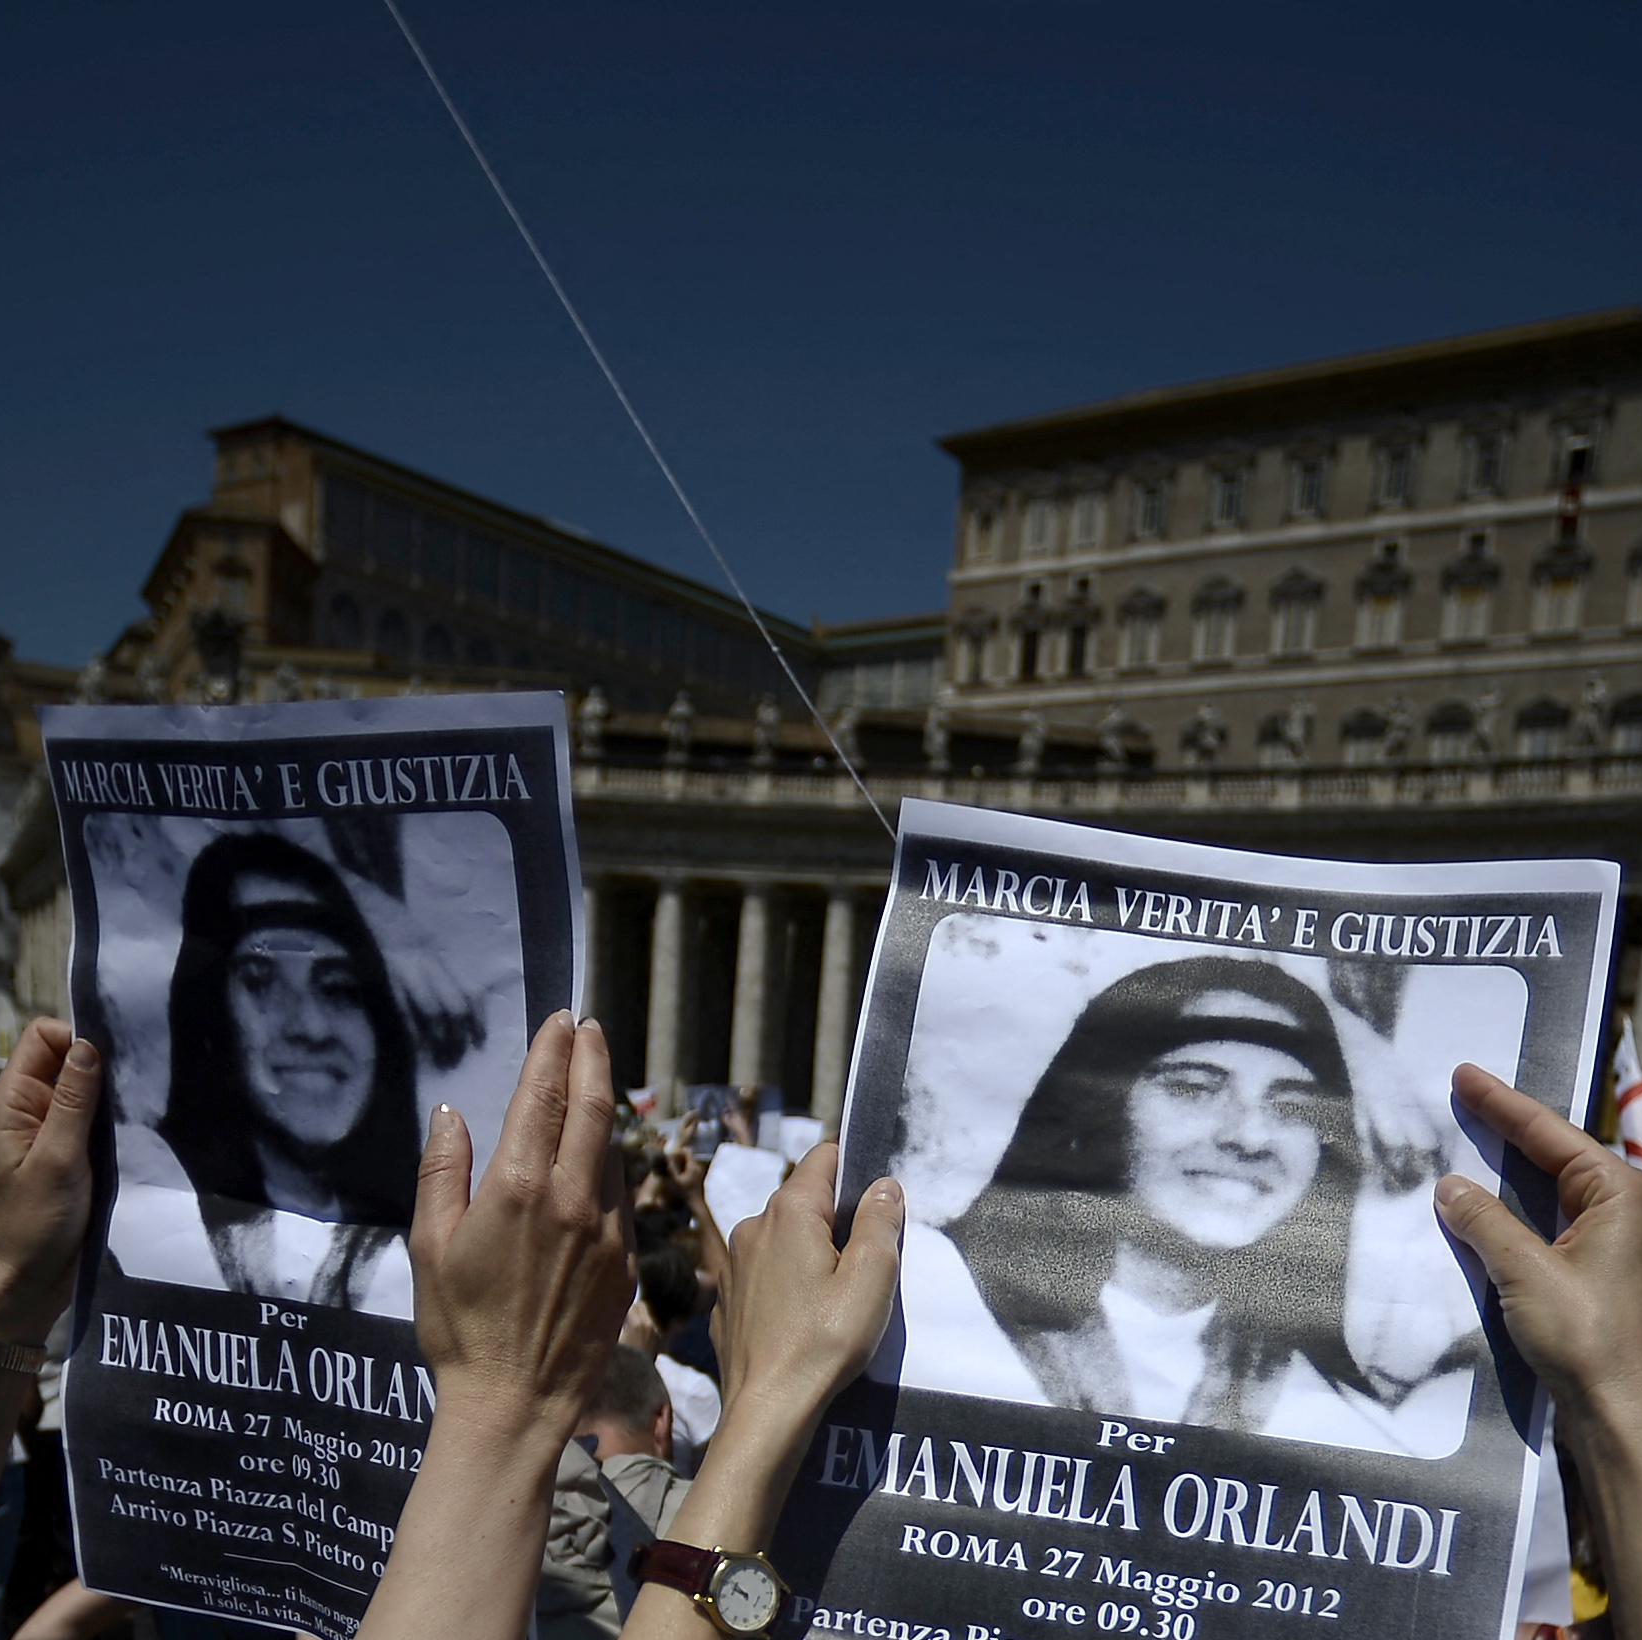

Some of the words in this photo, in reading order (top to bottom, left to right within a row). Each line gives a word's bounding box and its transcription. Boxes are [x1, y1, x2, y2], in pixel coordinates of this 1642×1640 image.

[61, 760, 155, 807] MARCIA
[157, 762, 263, 812] VERITA’
[277, 763, 306, 809] E
[317, 752, 532, 808] GIUSTIZIA
[918, 858, 1094, 925] MARCIA
[1114, 885, 1283, 945] VERITA’
[1291, 908, 1320, 949] E
[1330, 911, 1564, 959] GIUSTIZIA
[259, 1302, 308, 1330] Per
[99, 1312, 301, 1396] EMANUELA
[154, 1397, 235, 1434] ROMA
[243, 1413, 271, 1438] 27
[283, 1416, 362, 1463] Maggio
[369, 1438, 422, 1474] 2012
[1097, 1420, 1175, 1454] Per
[98, 1457, 203, 1498] Partenza
[210, 1477, 293, 1511] Piazza
[296, 1498, 326, 1523] del
[239, 1454, 285, 1474] ore
[291, 1454, 341, 1491] 09.30
[816, 1423, 1140, 1531] EMANUELA
[1163, 1472, 1461, 1576] ORLANDI
[110, 1493, 187, 1528] Arrivo
[193, 1508, 274, 1543] Piazza
[281, 1523, 301, 1548] S.
[305, 1529, 366, 1572] Pietro
[283, 1585, 297, 1601] ti
[299, 1588, 331, 1618] hanno
[900, 1524, 1028, 1571] ROMA
[1039, 1546, 1085, 1579] 27
[1092, 1555, 1241, 1610] Maggio
[1251, 1579, 1342, 1619] 2012
[203, 1590, 213, 1607] il
[216, 1593, 253, 1617] sole,
[256, 1601, 269, 1618] la
[273, 1604, 312, 1628] vita...
[1021, 1597, 1087, 1626] ore
